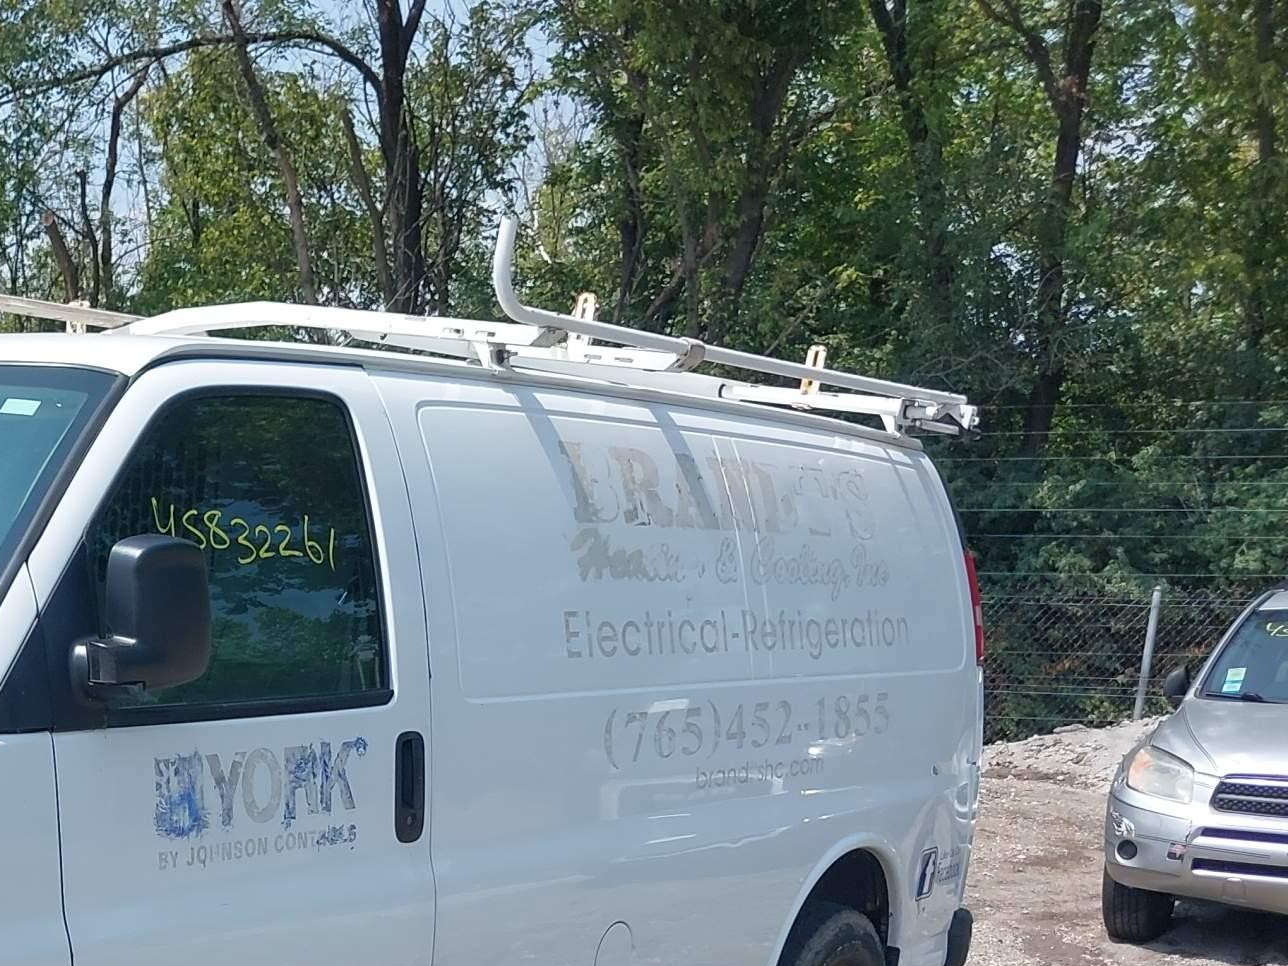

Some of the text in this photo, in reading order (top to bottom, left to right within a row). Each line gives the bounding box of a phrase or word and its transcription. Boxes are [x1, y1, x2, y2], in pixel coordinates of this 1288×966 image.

[152, 497, 336, 571] 45832261
[563, 608, 910, 660] Electrical-Refrigeration
[604, 692, 890, 769] (765)452-1855
[158, 851, 179, 870] BY
